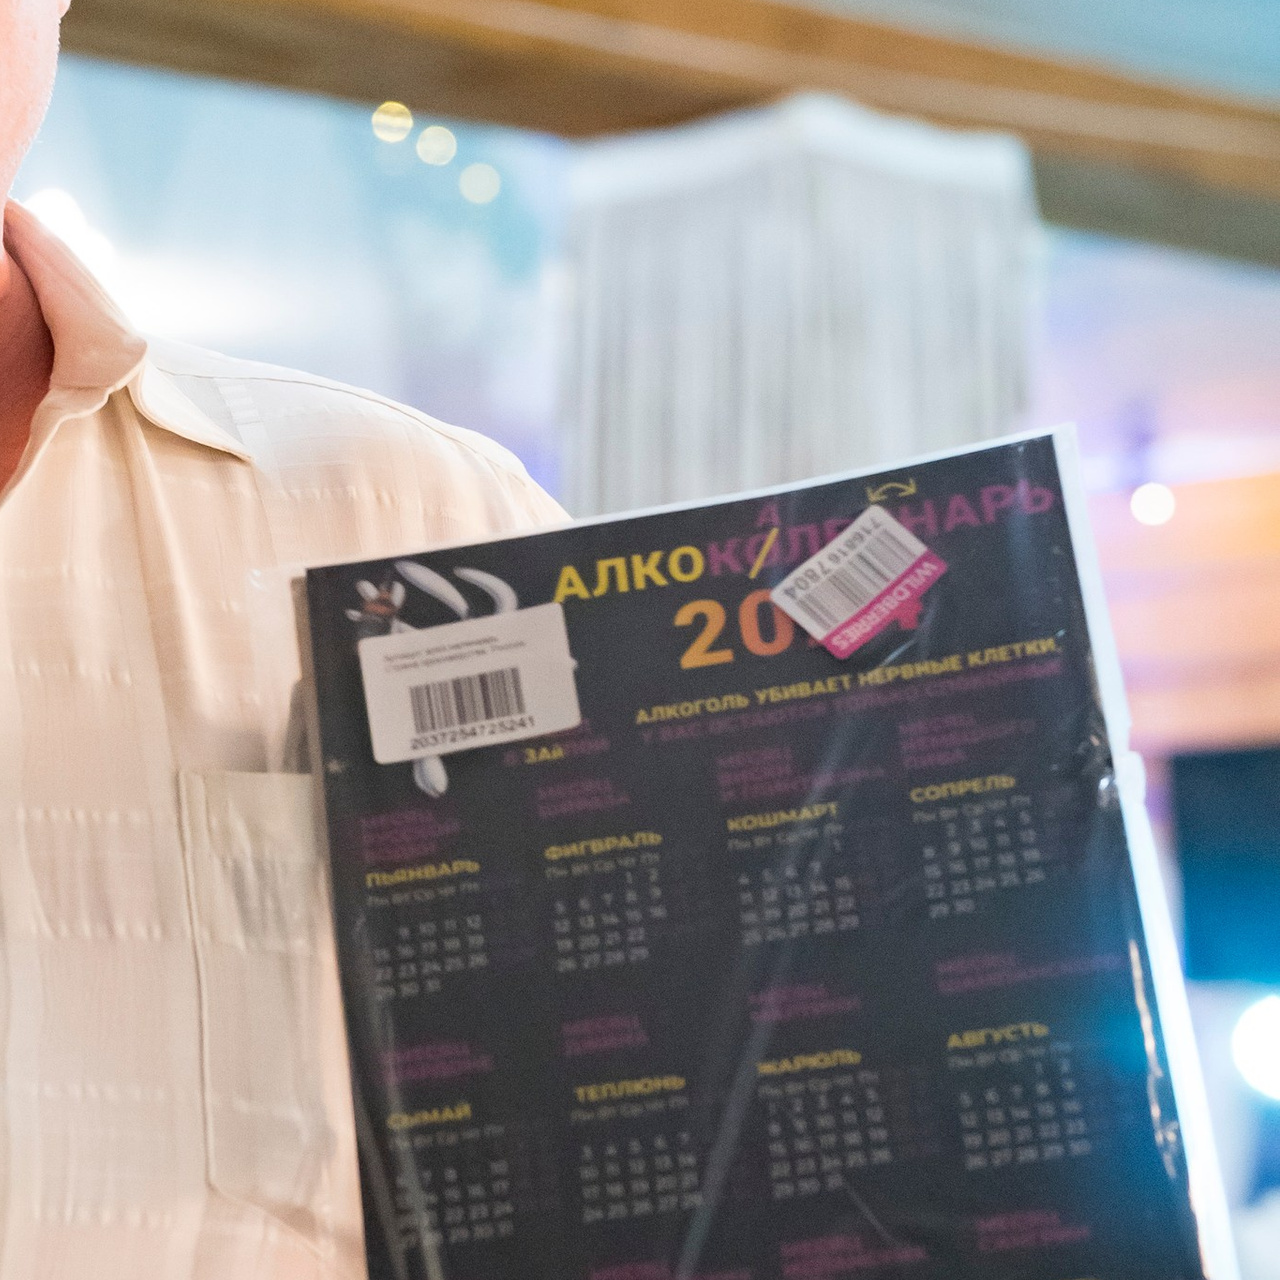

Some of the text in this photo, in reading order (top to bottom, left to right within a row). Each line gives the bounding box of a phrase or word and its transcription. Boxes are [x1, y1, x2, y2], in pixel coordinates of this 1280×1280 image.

[830, 559, 939, 651] WILDBERRIES
[635, 693, 750, 725] АЛКОГОЛЬ
[755, 675, 851, 704] УБИВАЕТ
[858, 655, 962, 686] НЕРВНЫЕ
[910, 774, 1016, 803] СОПРЕЛЬ
[726, 801, 839, 832] КОШМАРТ
[544, 831, 663, 860] ФИГВРАЛЬ
[366, 860, 480, 888] ПЬЯНВАРЬ
[947, 1022, 1050, 1050] АВГУСТЬ
[575, 1075, 686, 1103] ТЕПЛЮНЬ
